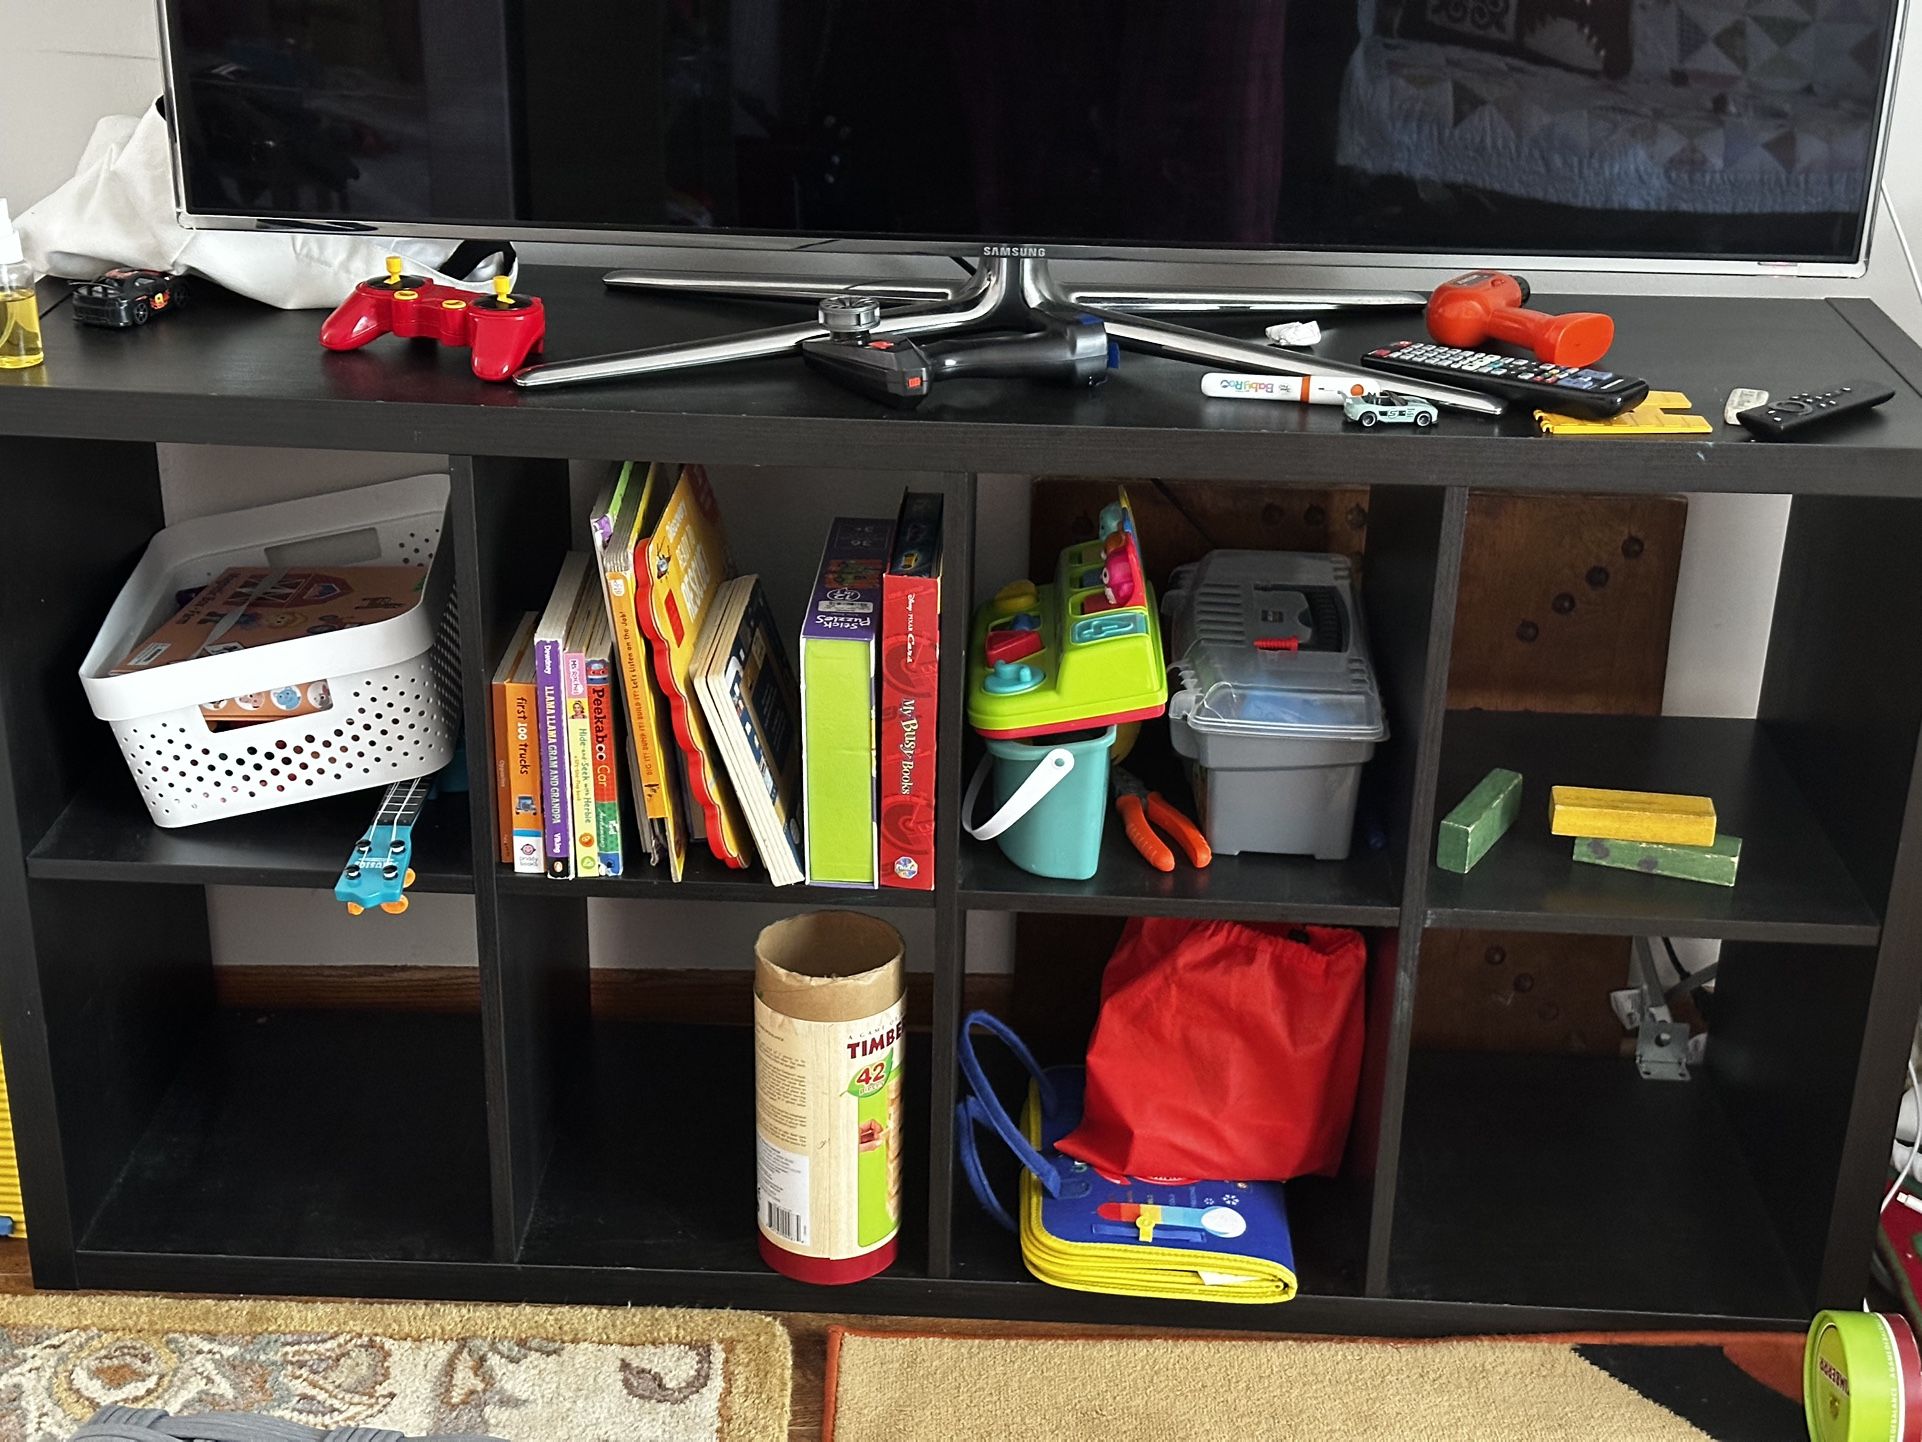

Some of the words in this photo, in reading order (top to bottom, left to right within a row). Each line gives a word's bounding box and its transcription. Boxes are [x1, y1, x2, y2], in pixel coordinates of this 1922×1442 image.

[983, 246, 1046, 257] SAMSUNG
[823, 622, 859, 631] Stick
[626, 642, 632, 650] on
[544, 645, 553, 674] Dewdney
[516, 697, 528, 720] first
[544, 686, 555, 714] LLAMA
[901, 699, 916, 718] My
[517, 722, 528, 742] 100
[546, 715, 557, 744] LLAMA
[592, 687, 607, 761] Peekaboo
[901, 719, 918, 760] Busy
[518, 743, 530, 775] trucks
[547, 745, 558, 769] GRAM
[549, 769, 559, 787] AND
[597, 765, 610, 787] Car
[900, 760, 914, 795] Books
[550, 787, 561, 824] GRANDPA
[583, 797, 592, 823] Herbie
[552, 833, 562, 854] Viking
[856, 1063, 886, 1086] 42
